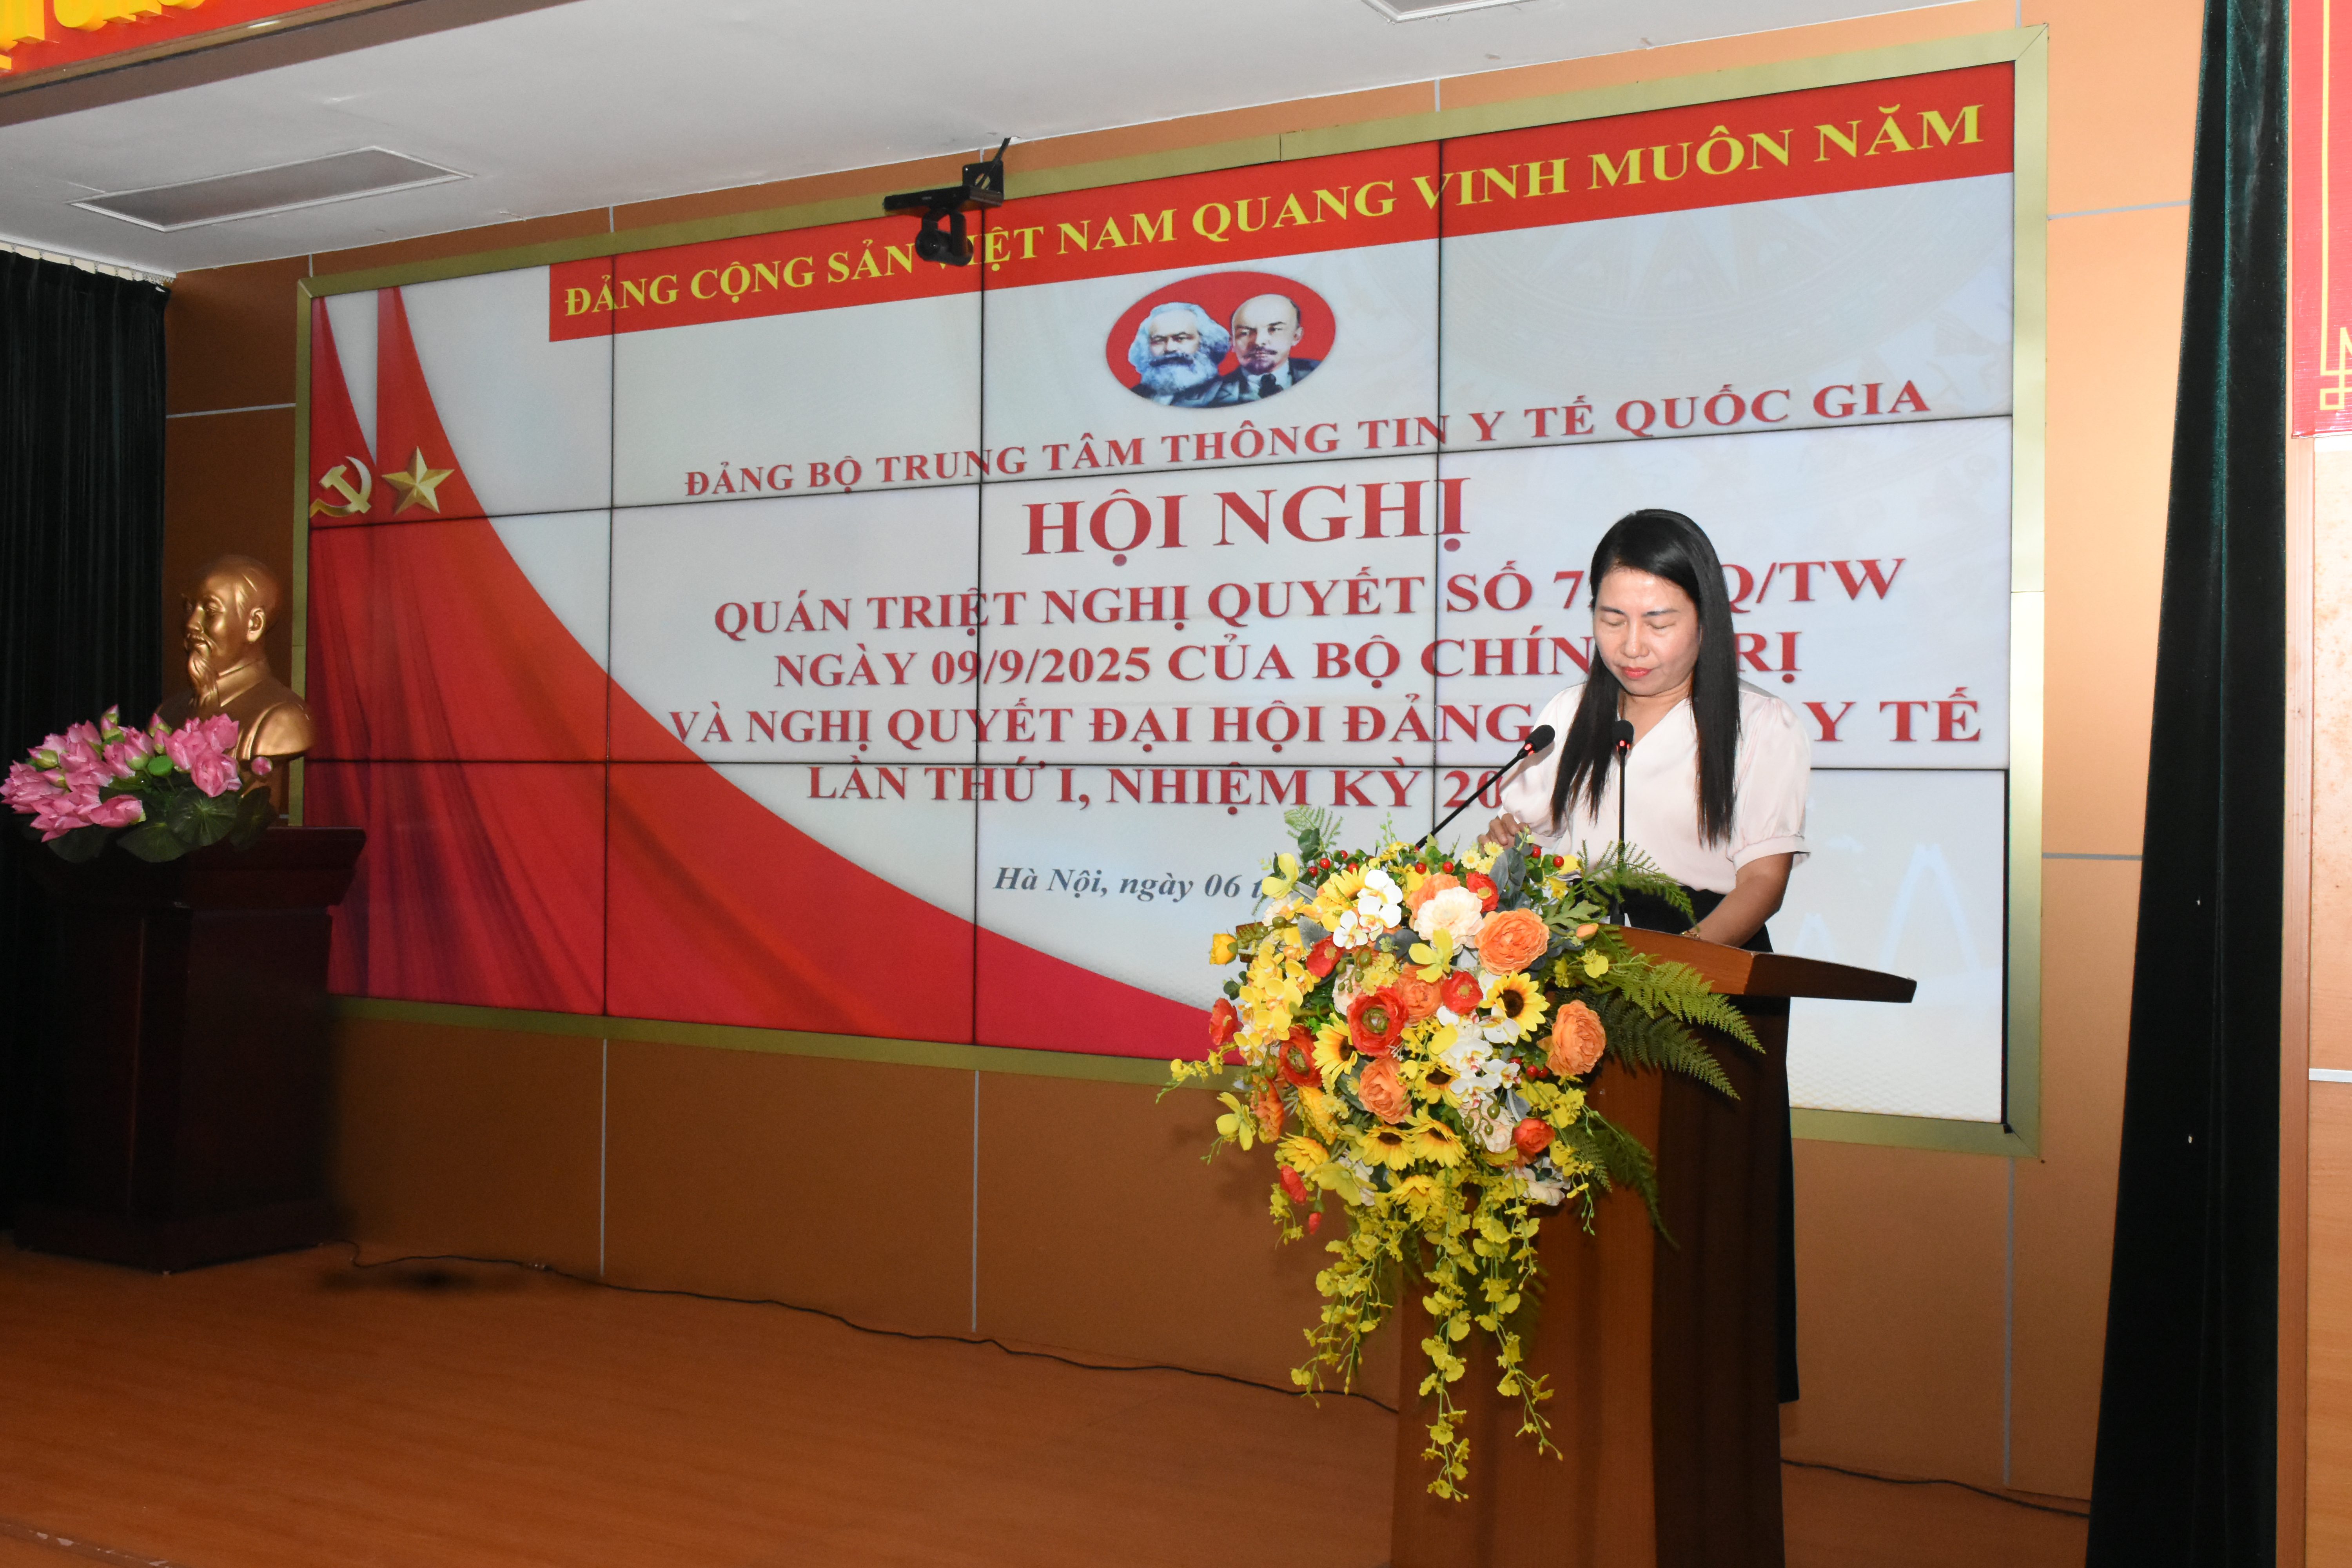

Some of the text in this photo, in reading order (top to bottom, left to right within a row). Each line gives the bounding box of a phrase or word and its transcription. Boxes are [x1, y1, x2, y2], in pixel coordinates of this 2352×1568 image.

[565, 274, 678, 316] ĐẢNG
[690, 256, 815, 303] CỘNG
[828, 239, 915, 283] SẢN
[1057, 209, 1177, 254] NAM
[1192, 180, 1397, 242] QUANG
[1412, 158, 1570, 209] VINH
[1588, 125, 1794, 189] MUÔN
[1814, 103, 1984, 162] NĂM
[687, 380, 1931, 496] ĐẢNG BỘ TRUNG TÂM THÔNG TIN Y TẾ QUỐC GIA
[1025, 477, 1470, 566] HỘI NGHỊ
[715, 589, 851, 642] QUÁN
[866, 587, 1027, 637] TRIỆT
[1043, 585, 1188, 631] NGHỊ
[1208, 566, 1425, 628] QUYẾT
[1446, 560, 1533, 612] SỐ
[777, 624, 1800, 689] NGÀY 09/9/2025 CỦA BỘ CHÍN RỊ
[668, 686, 1981, 753] VÀ NGHỊ QUYẾT ĐẠI HỘI ĐẢNG Y TẾ
[924, 755, 1046, 802] THỨ
[1060, 768, 1091, 808] I,
[1107, 760, 1309, 815] NHIỆM
[1332, 755, 1421, 808] KỲ
[1443, 769, 1503, 809] 20
[993, 867, 1038, 891] Hà
[1046, 869, 1108, 898] Nội,
[1119, 872, 1194, 903] ngày
[1204, 874, 1242, 898] 06
